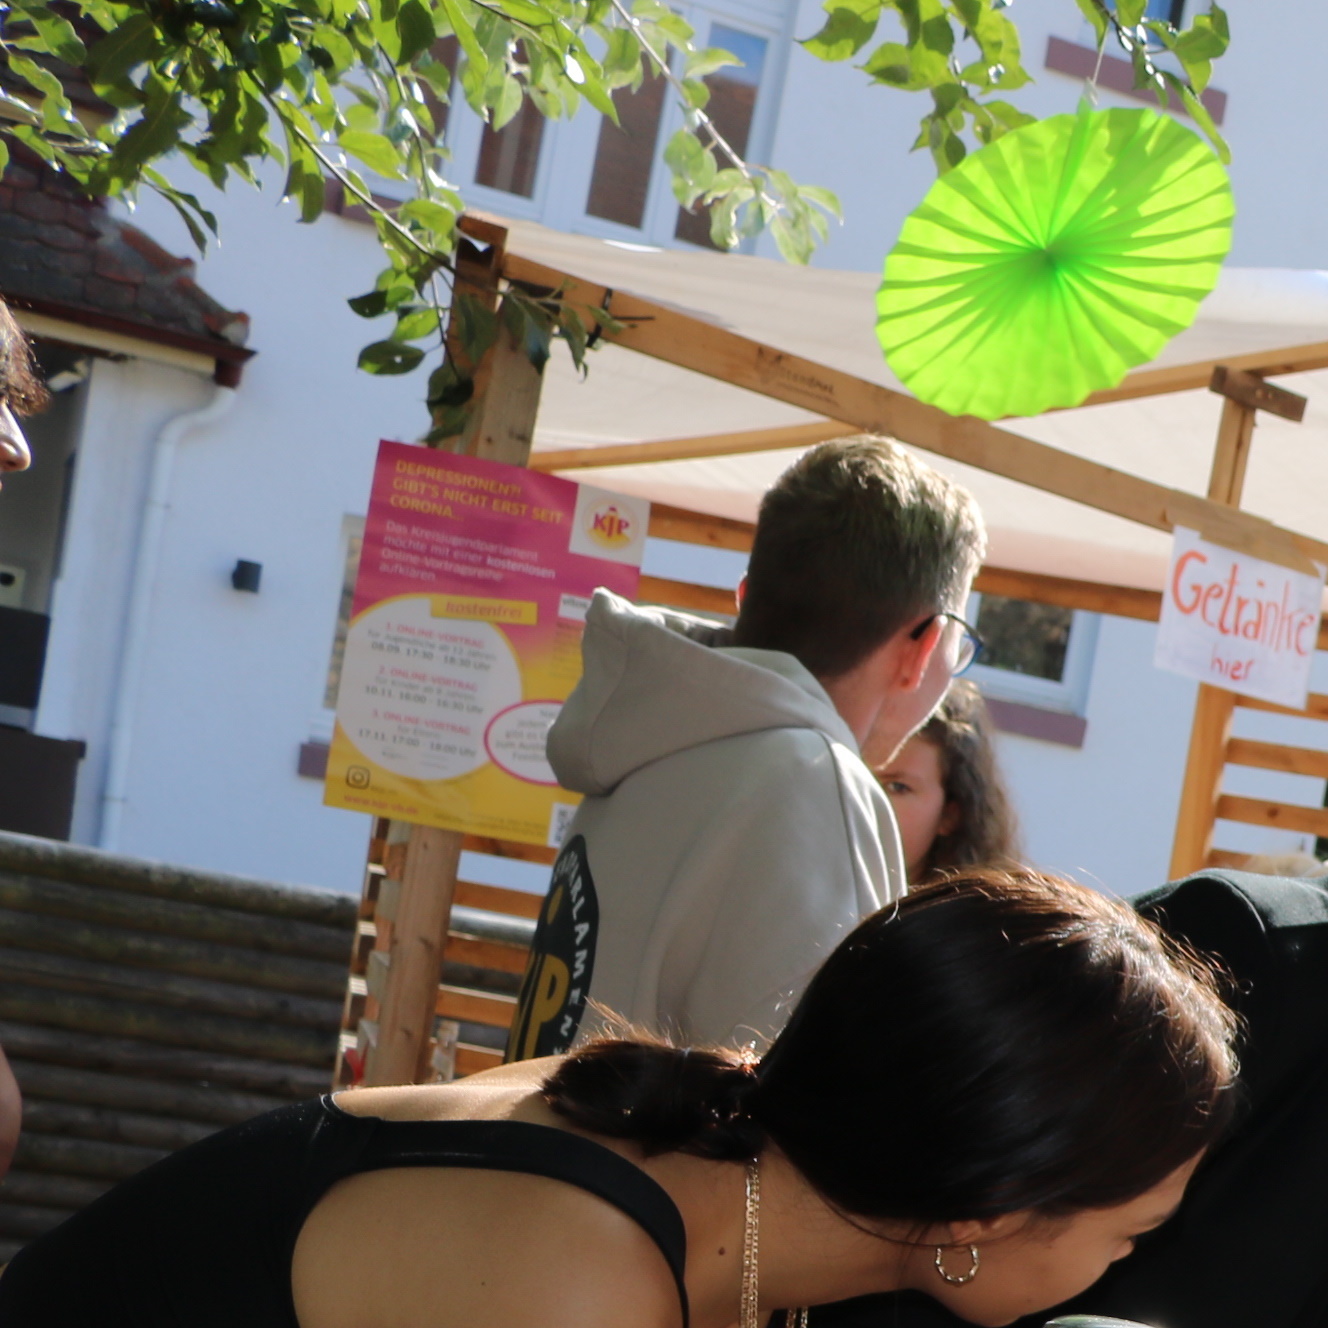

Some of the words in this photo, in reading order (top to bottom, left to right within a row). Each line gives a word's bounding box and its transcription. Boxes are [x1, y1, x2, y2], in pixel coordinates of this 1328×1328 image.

[392, 477, 439, 498] GIBT'S
[443, 487, 488, 508] NICHT
[492, 498, 529, 517] ERST
[531, 506, 564, 524] SEIT
[1210, 642, 1255, 682] hier
